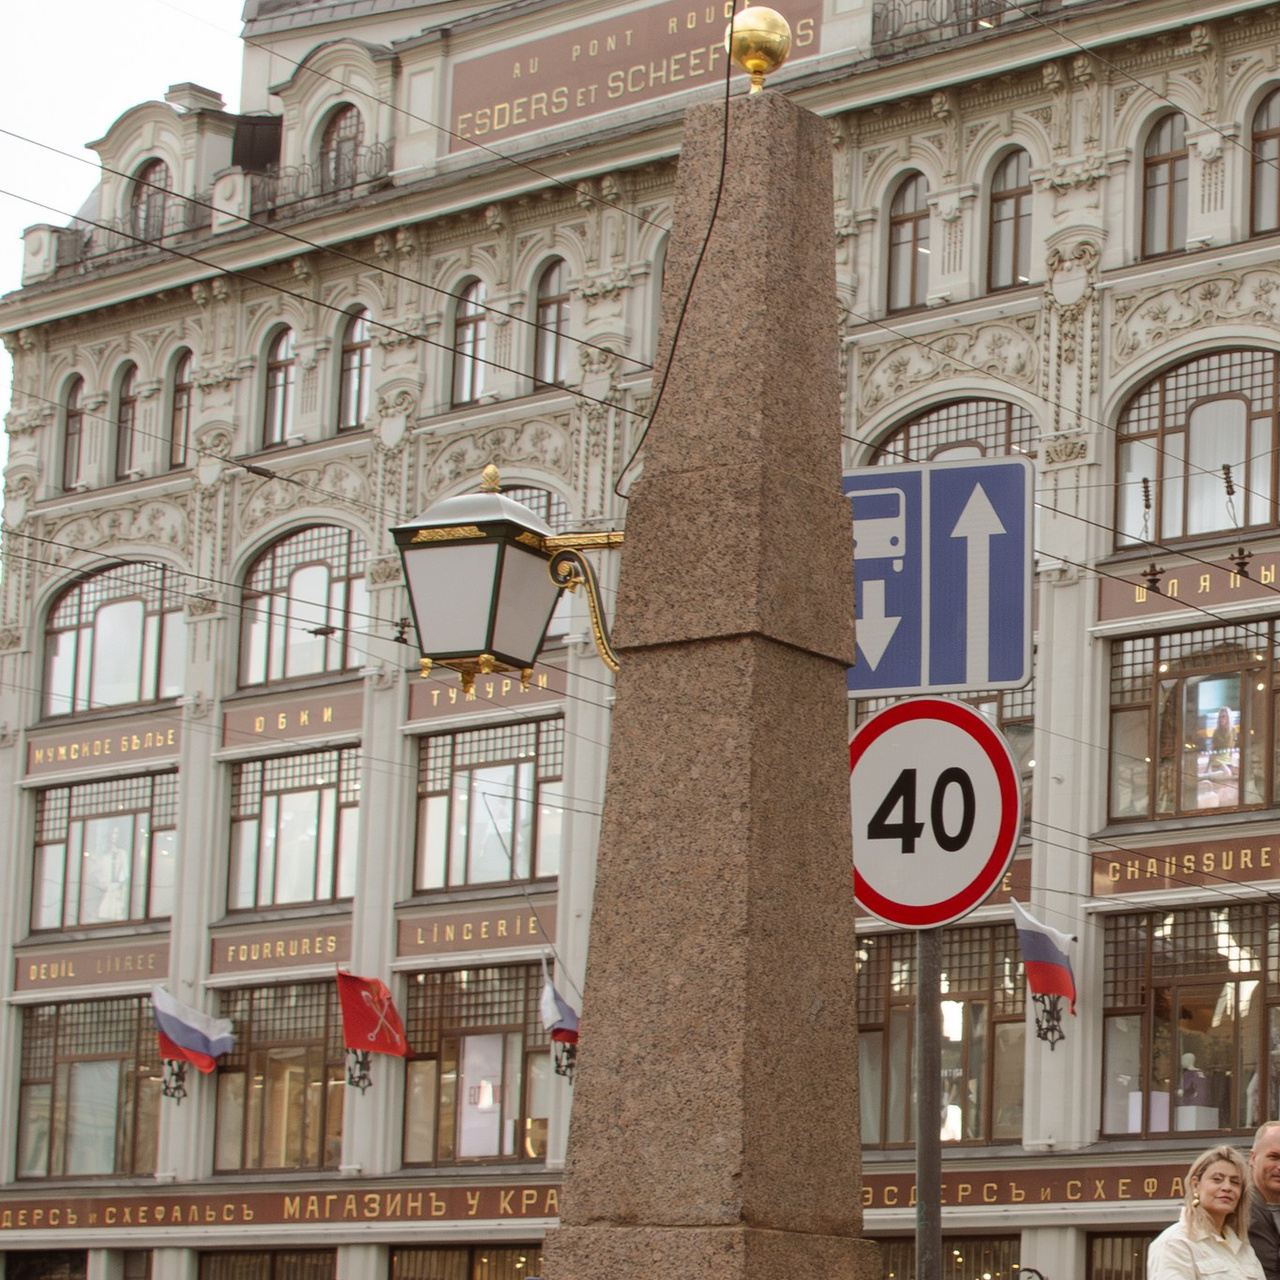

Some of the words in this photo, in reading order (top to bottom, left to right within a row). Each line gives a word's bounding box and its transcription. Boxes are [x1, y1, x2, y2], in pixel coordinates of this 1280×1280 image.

[513, 57, 539, 79] AU
[571, 30, 633, 61] PONT
[457, 86, 569, 140] ESDERS
[576, 85, 598, 107] ET
[607, 18, 814, 98] SCHEEFS
[1135, 564, 1275, 603] ШЛЯПЫ
[255, 706, 332, 732] ЮБКИ
[34, 739, 112, 764] МУЖСКОЕ
[867, 767, 975, 854] 40
[227, 935, 337, 962] FOURRURES
[104, 1204, 254, 1224] СХЕФАЛЬСЪ
[283, 1192, 446, 1219] МАГАЗИНЪ
[466, 1190, 480, 1215] У
